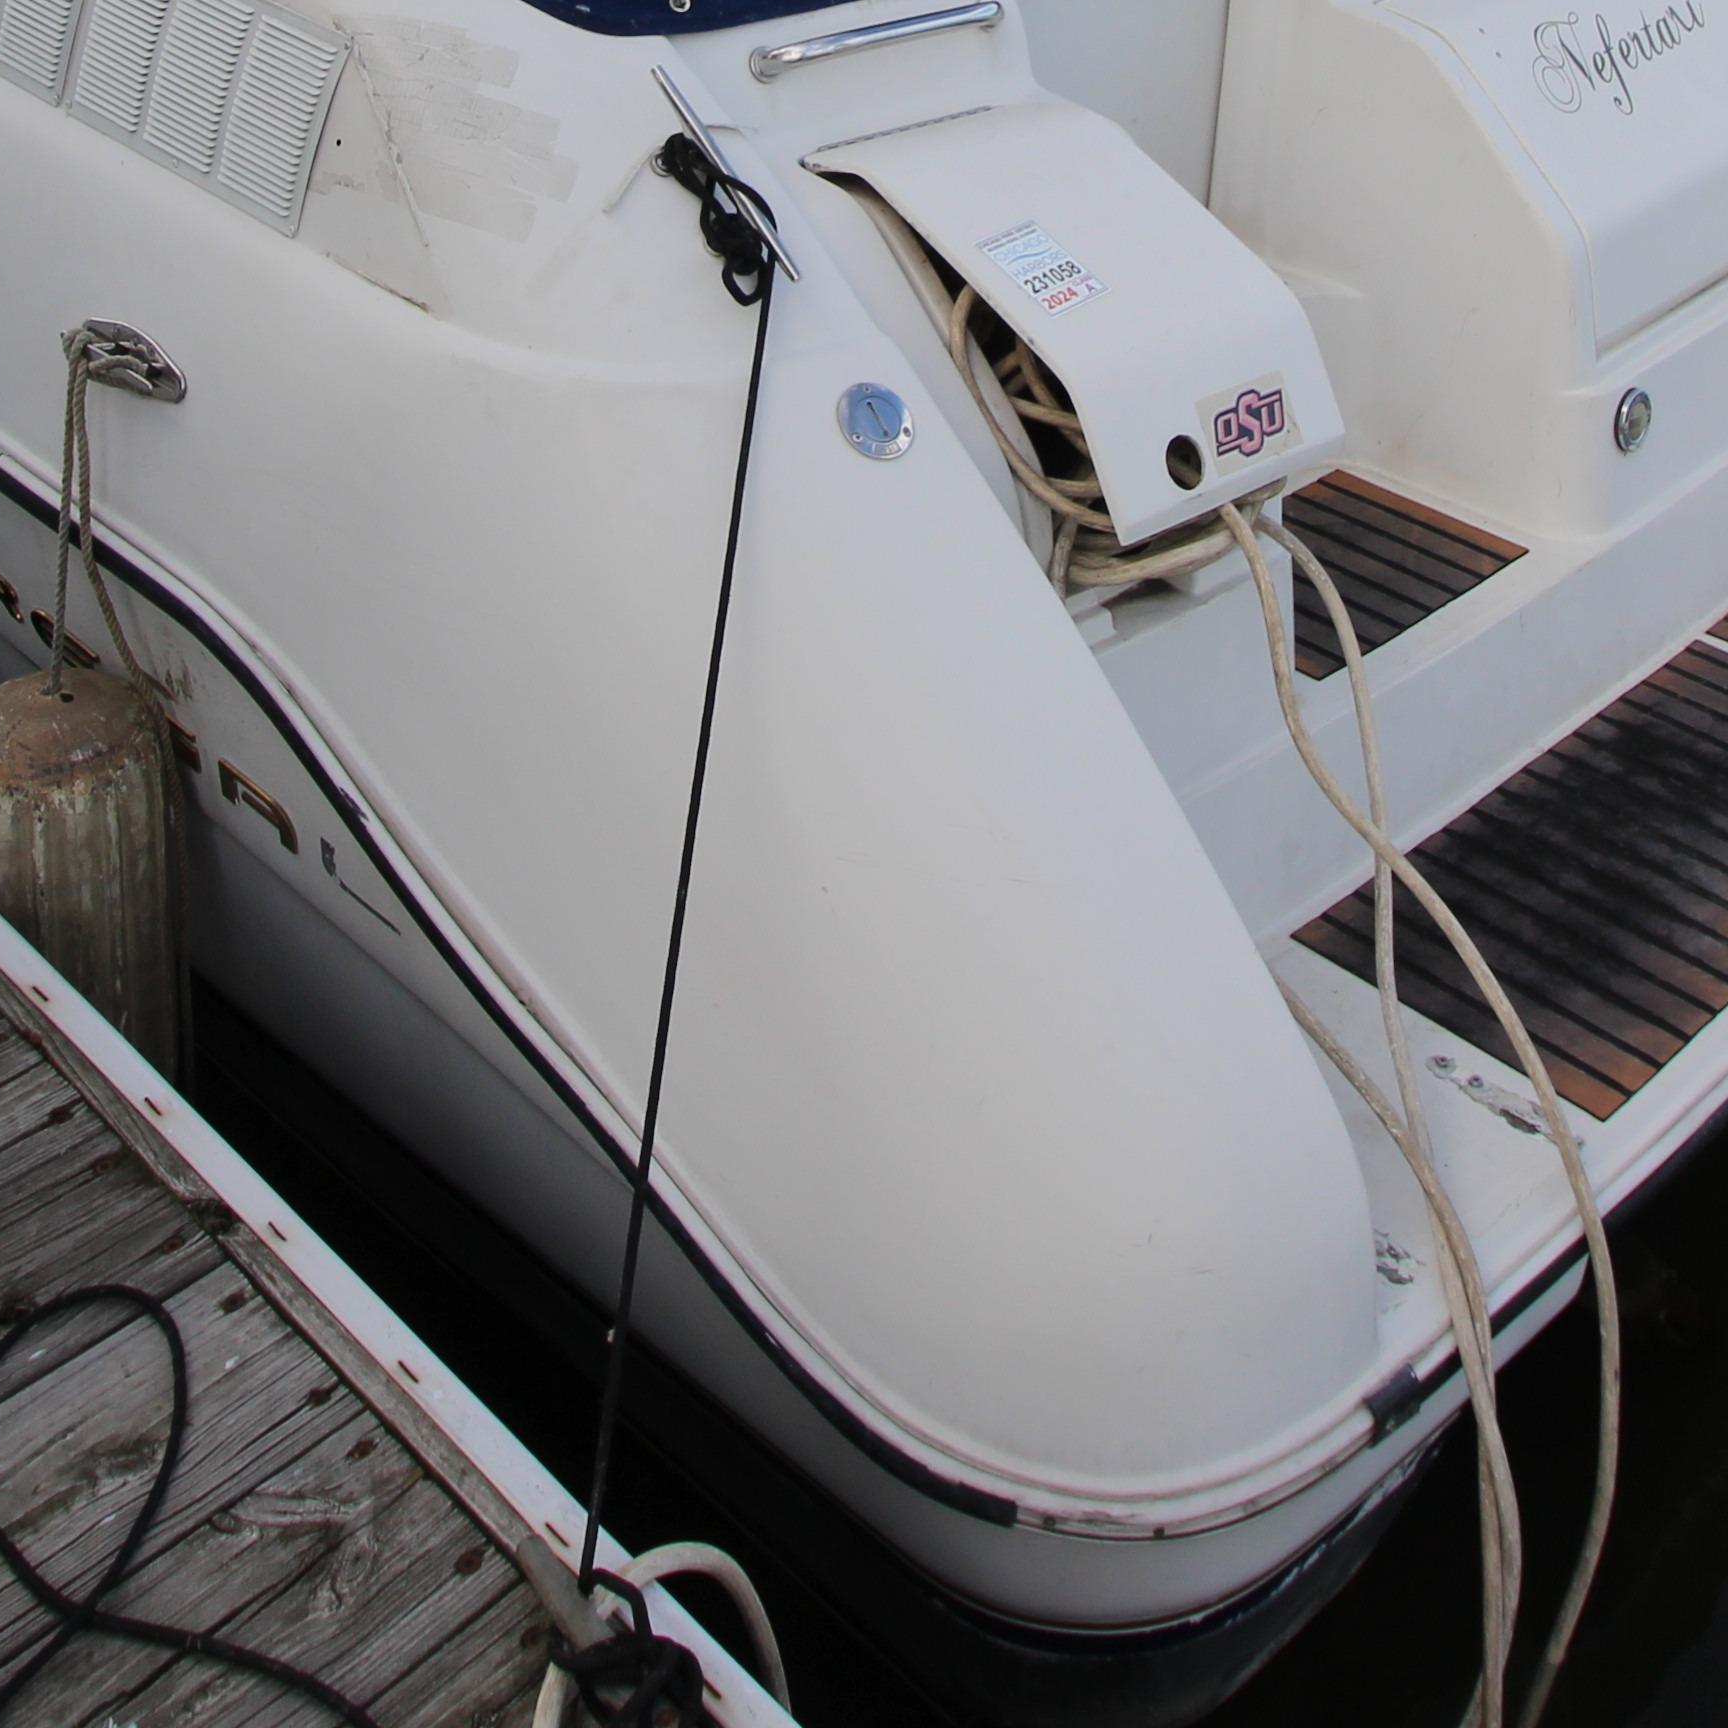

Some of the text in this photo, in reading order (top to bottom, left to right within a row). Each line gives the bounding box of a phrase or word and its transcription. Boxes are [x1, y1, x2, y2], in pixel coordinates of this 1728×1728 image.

[1024, 260, 1082, 294] 231058
[1041, 286, 1079, 310] 2024
[1214, 388, 1285, 457] OSU
